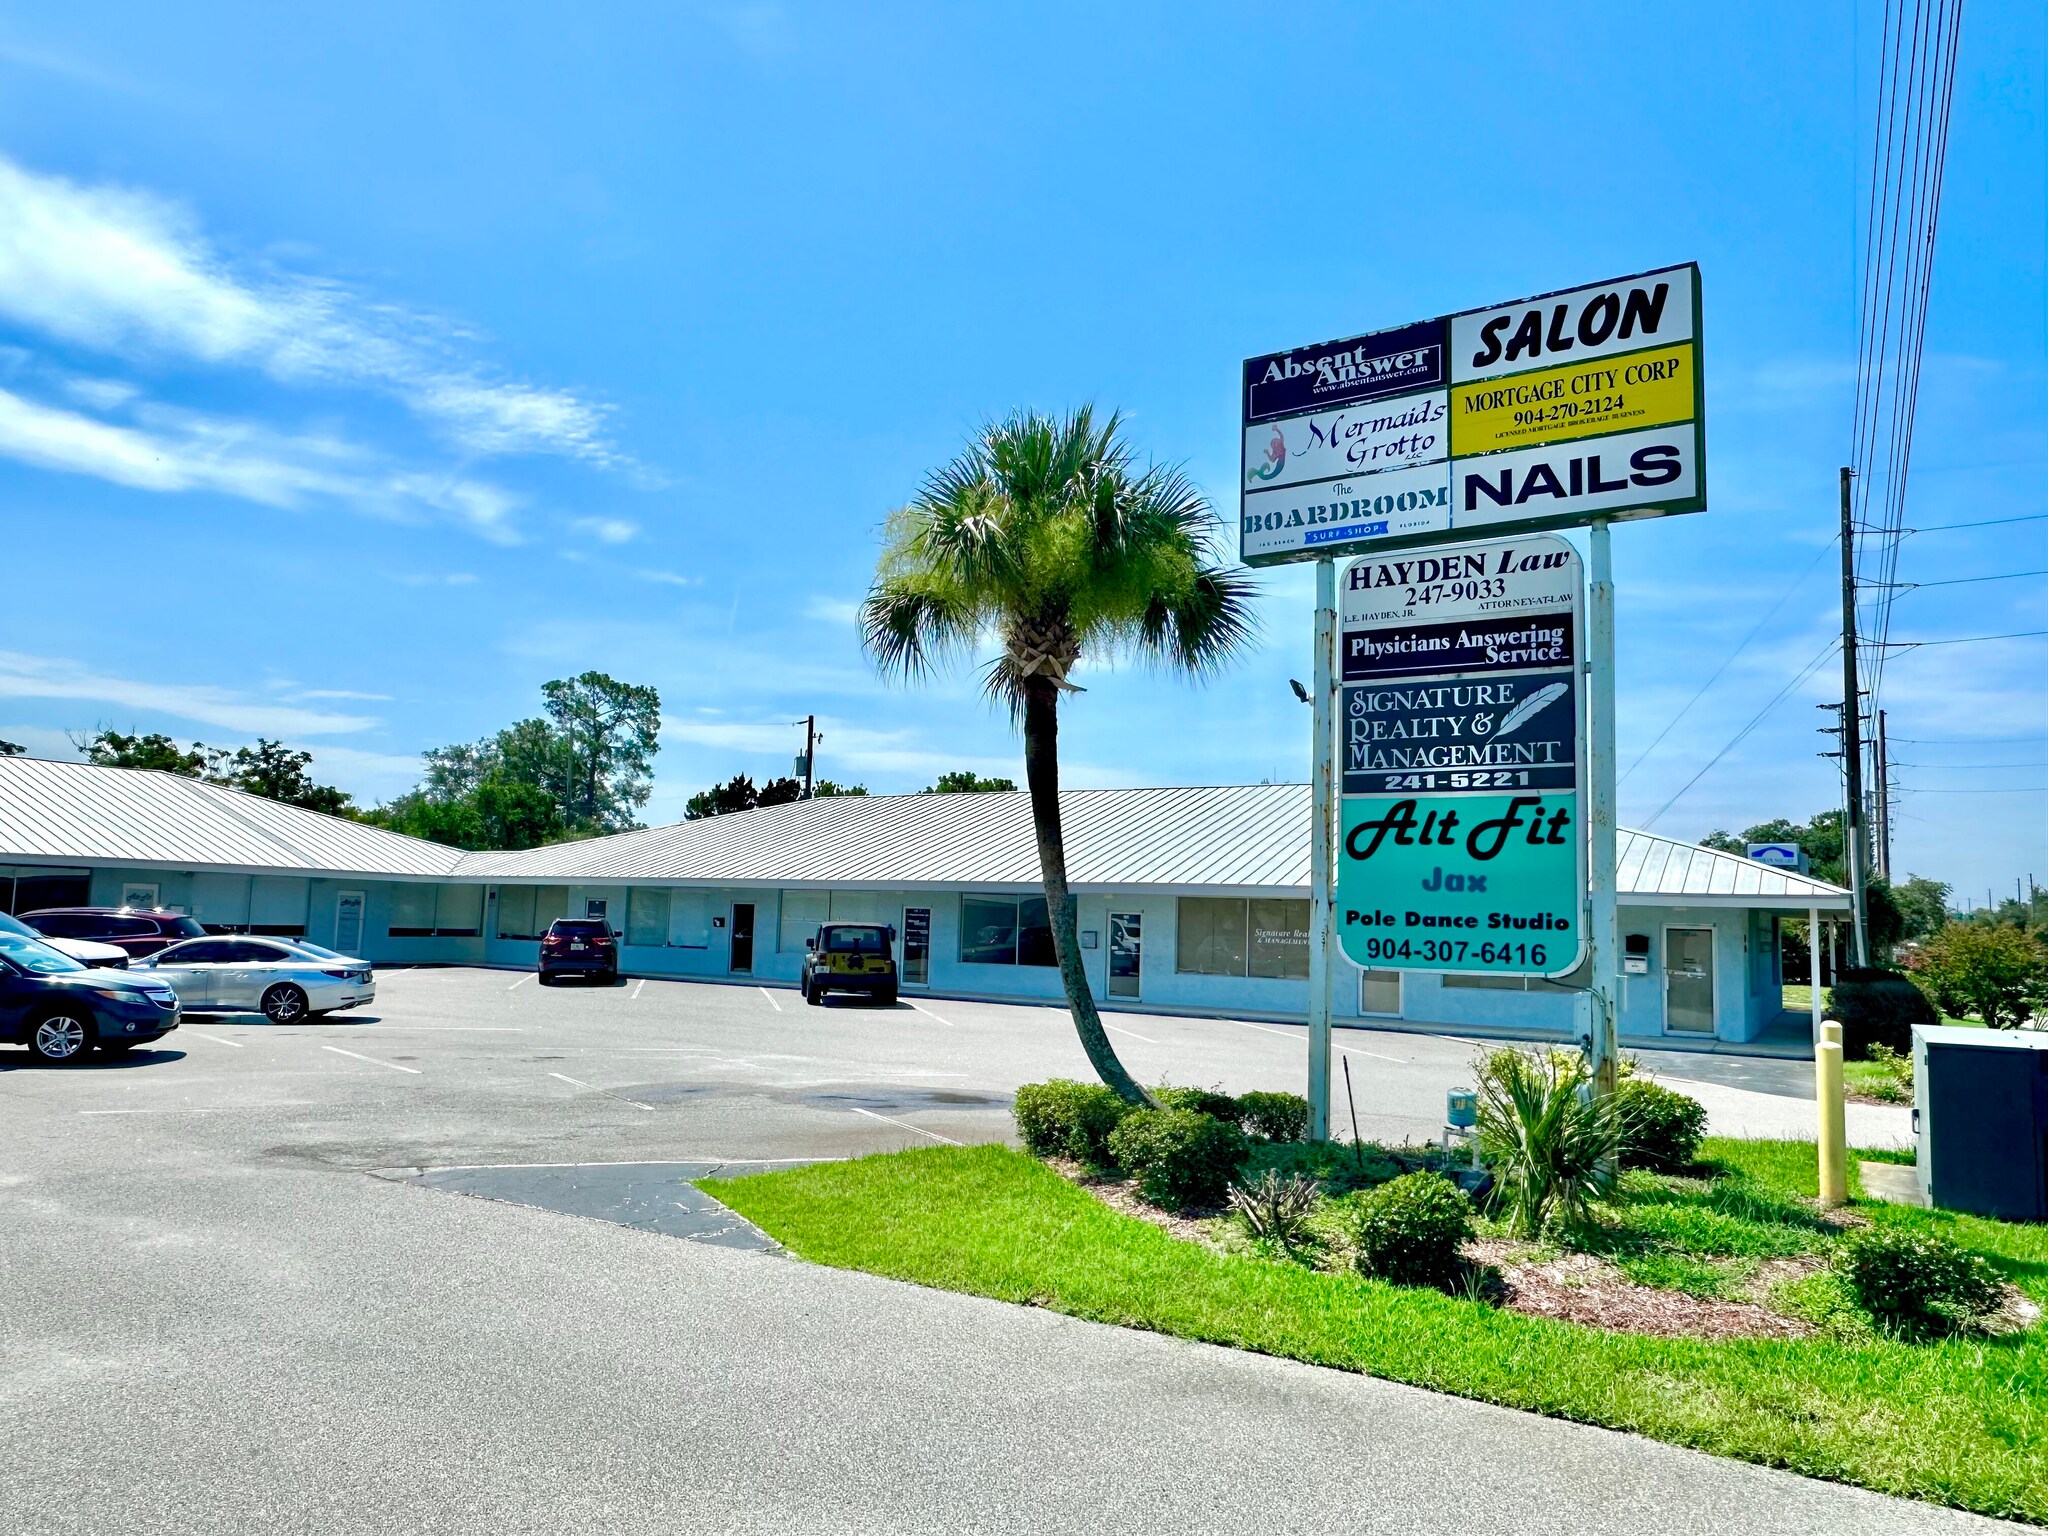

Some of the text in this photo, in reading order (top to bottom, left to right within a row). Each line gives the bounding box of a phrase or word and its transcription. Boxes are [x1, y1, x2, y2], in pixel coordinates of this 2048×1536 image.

[1472, 283, 1669, 368] SALON
[1261, 345, 1366, 384] Absent
[1312, 365, 1428, 394] www.absentanswer.com
[1313, 349, 1429, 388] Answer
[1465, 358, 1680, 414] MORTGAGE CITY CORP
[1514, 394, 1625, 428] 904-270-2124
[1292, 399, 1447, 457] Mermaids
[1345, 432, 1436, 473] Grotto
[1333, 483, 1354, 497] The
[1465, 445, 1682, 511] NAILS
[1244, 486, 1448, 534] BOARDROOM
[1313, 525, 1379, 542] SURF SHOP
[1349, 549, 1570, 591] HAYDEN Law
[1404, 578, 1506, 607] 247-9033
[1478, 593, 1573, 610] ATTORNEY-AT-LAW
[1401, 609, 1416, 618] JR.
[1351, 624, 1565, 660] Physicians Answering
[1485, 642, 1562, 665] Service
[1349, 683, 1515, 717] SIGNATURE
[1349, 712, 1495, 744] REALTY &
[1349, 741, 1561, 770] MANAGEMENT
[1385, 771, 1529, 790] 241-5221
[1345, 796, 1571, 861] Alt Fit
[1421, 866, 1488, 893] Jax
[1255, 928, 1291, 938] Signature
[1346, 909, 1570, 931] Pole Dance Studio
[1366, 937, 1547, 966] 904-307-6416
